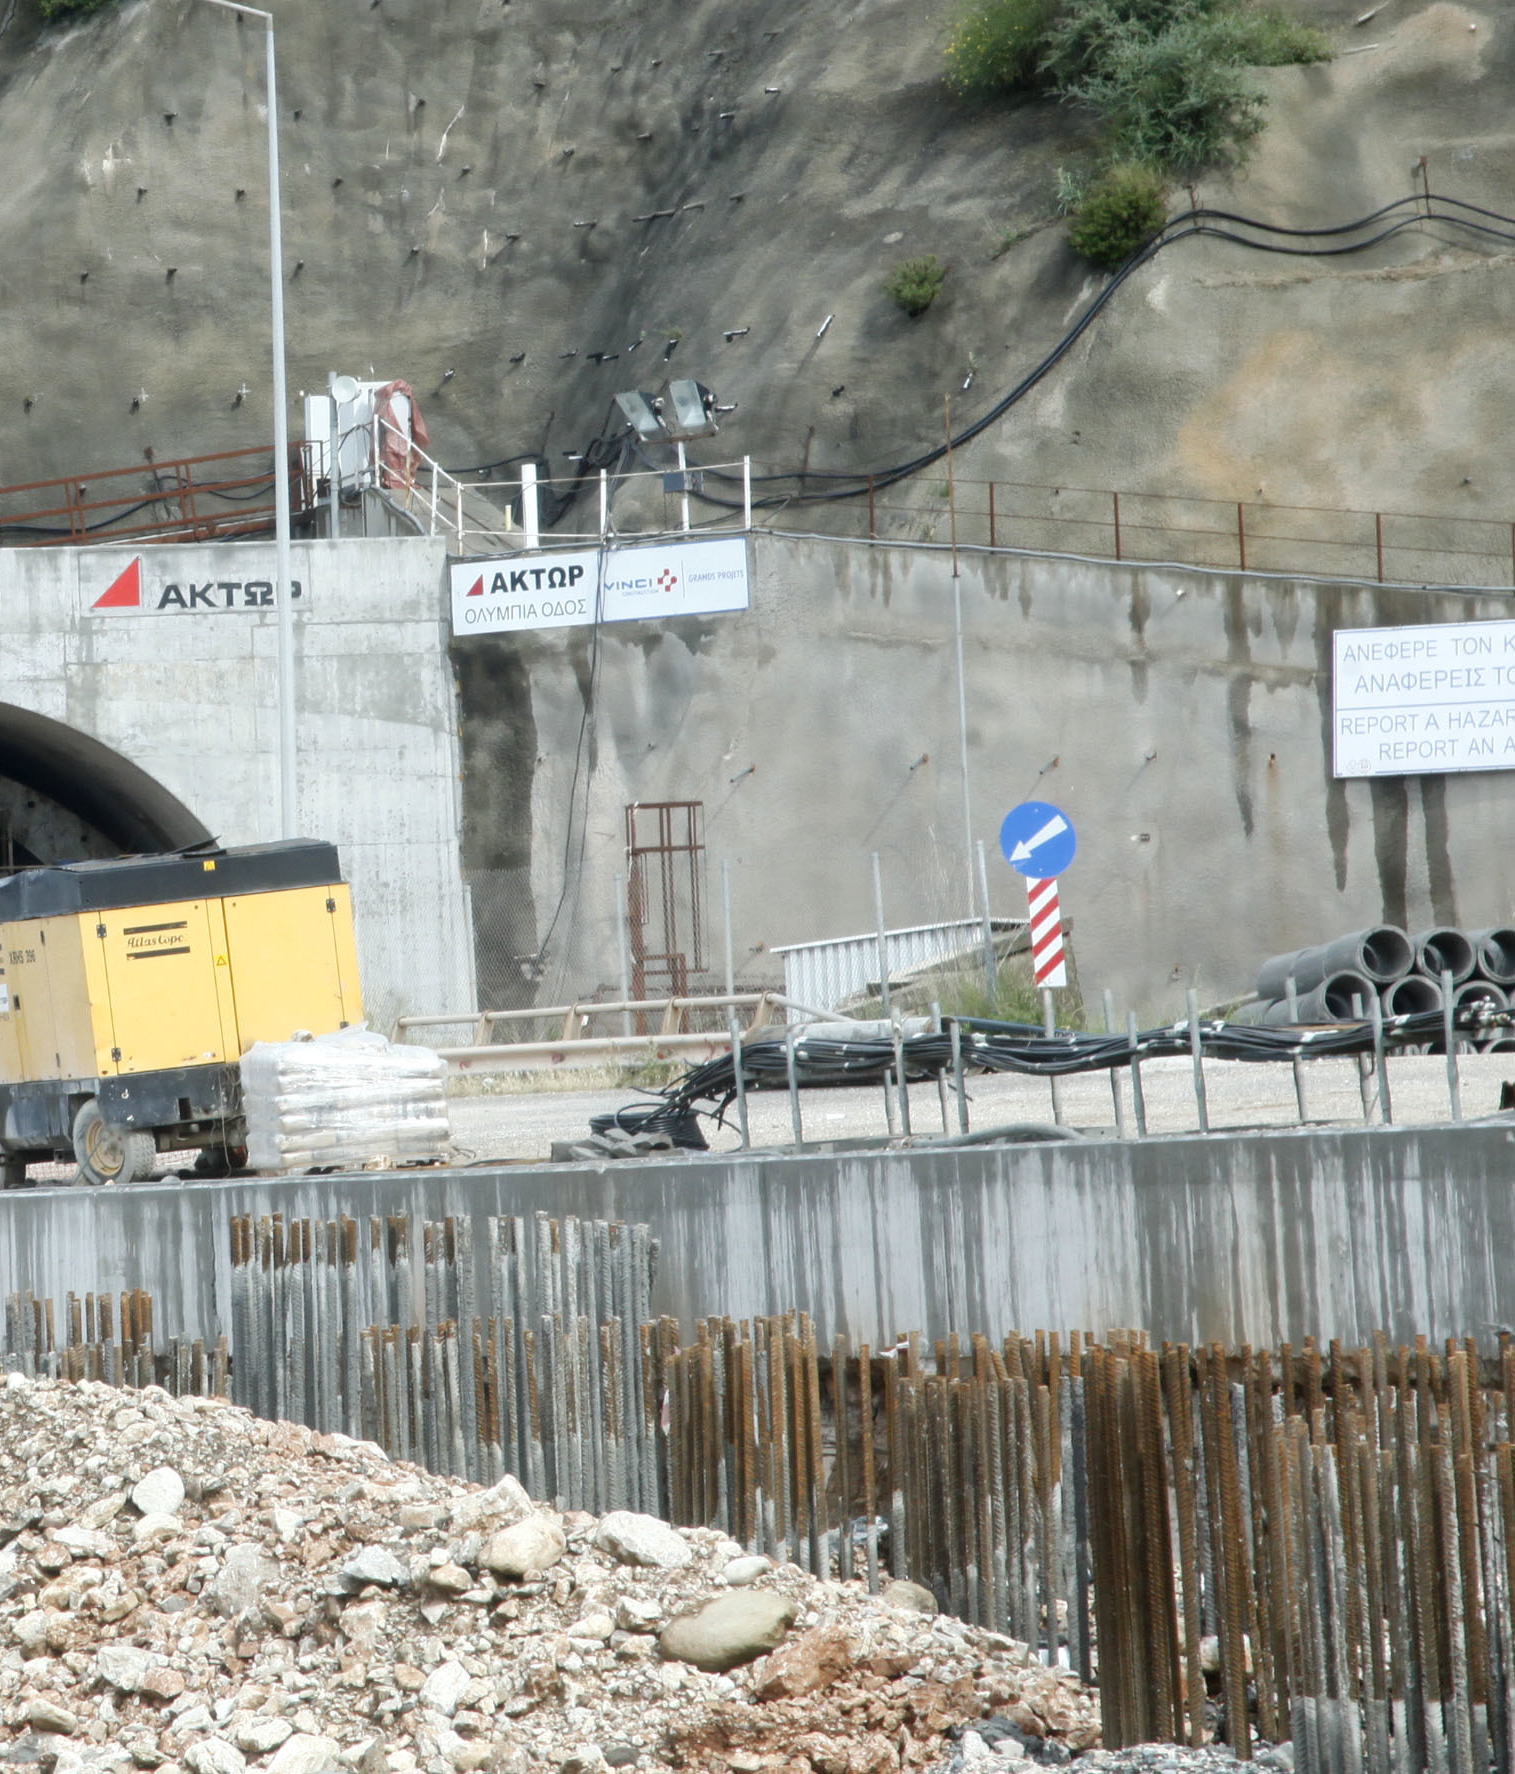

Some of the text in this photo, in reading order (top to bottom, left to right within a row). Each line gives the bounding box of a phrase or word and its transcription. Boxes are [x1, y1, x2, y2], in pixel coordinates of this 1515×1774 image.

[490, 565, 584, 594] ΑΚΤΩΡ
[604, 578, 652, 591] VINCI
[465, 599, 586, 624] ΟΛΥΜΠΙΑ ΟΔΟΣ
[1343, 639, 1438, 663] ΑΝΕΦΕΡΕ
[1451, 636, 1492, 656] ΤΟΝ
[1354, 667, 1486, 694] ΑΝΑΦΕΡΕΙΣ
[1341, 714, 1419, 735] REPORT
[1424, 713, 1440, 730] A
[1379, 739, 1459, 760] REPORT
[1468, 737, 1494, 756] AN
